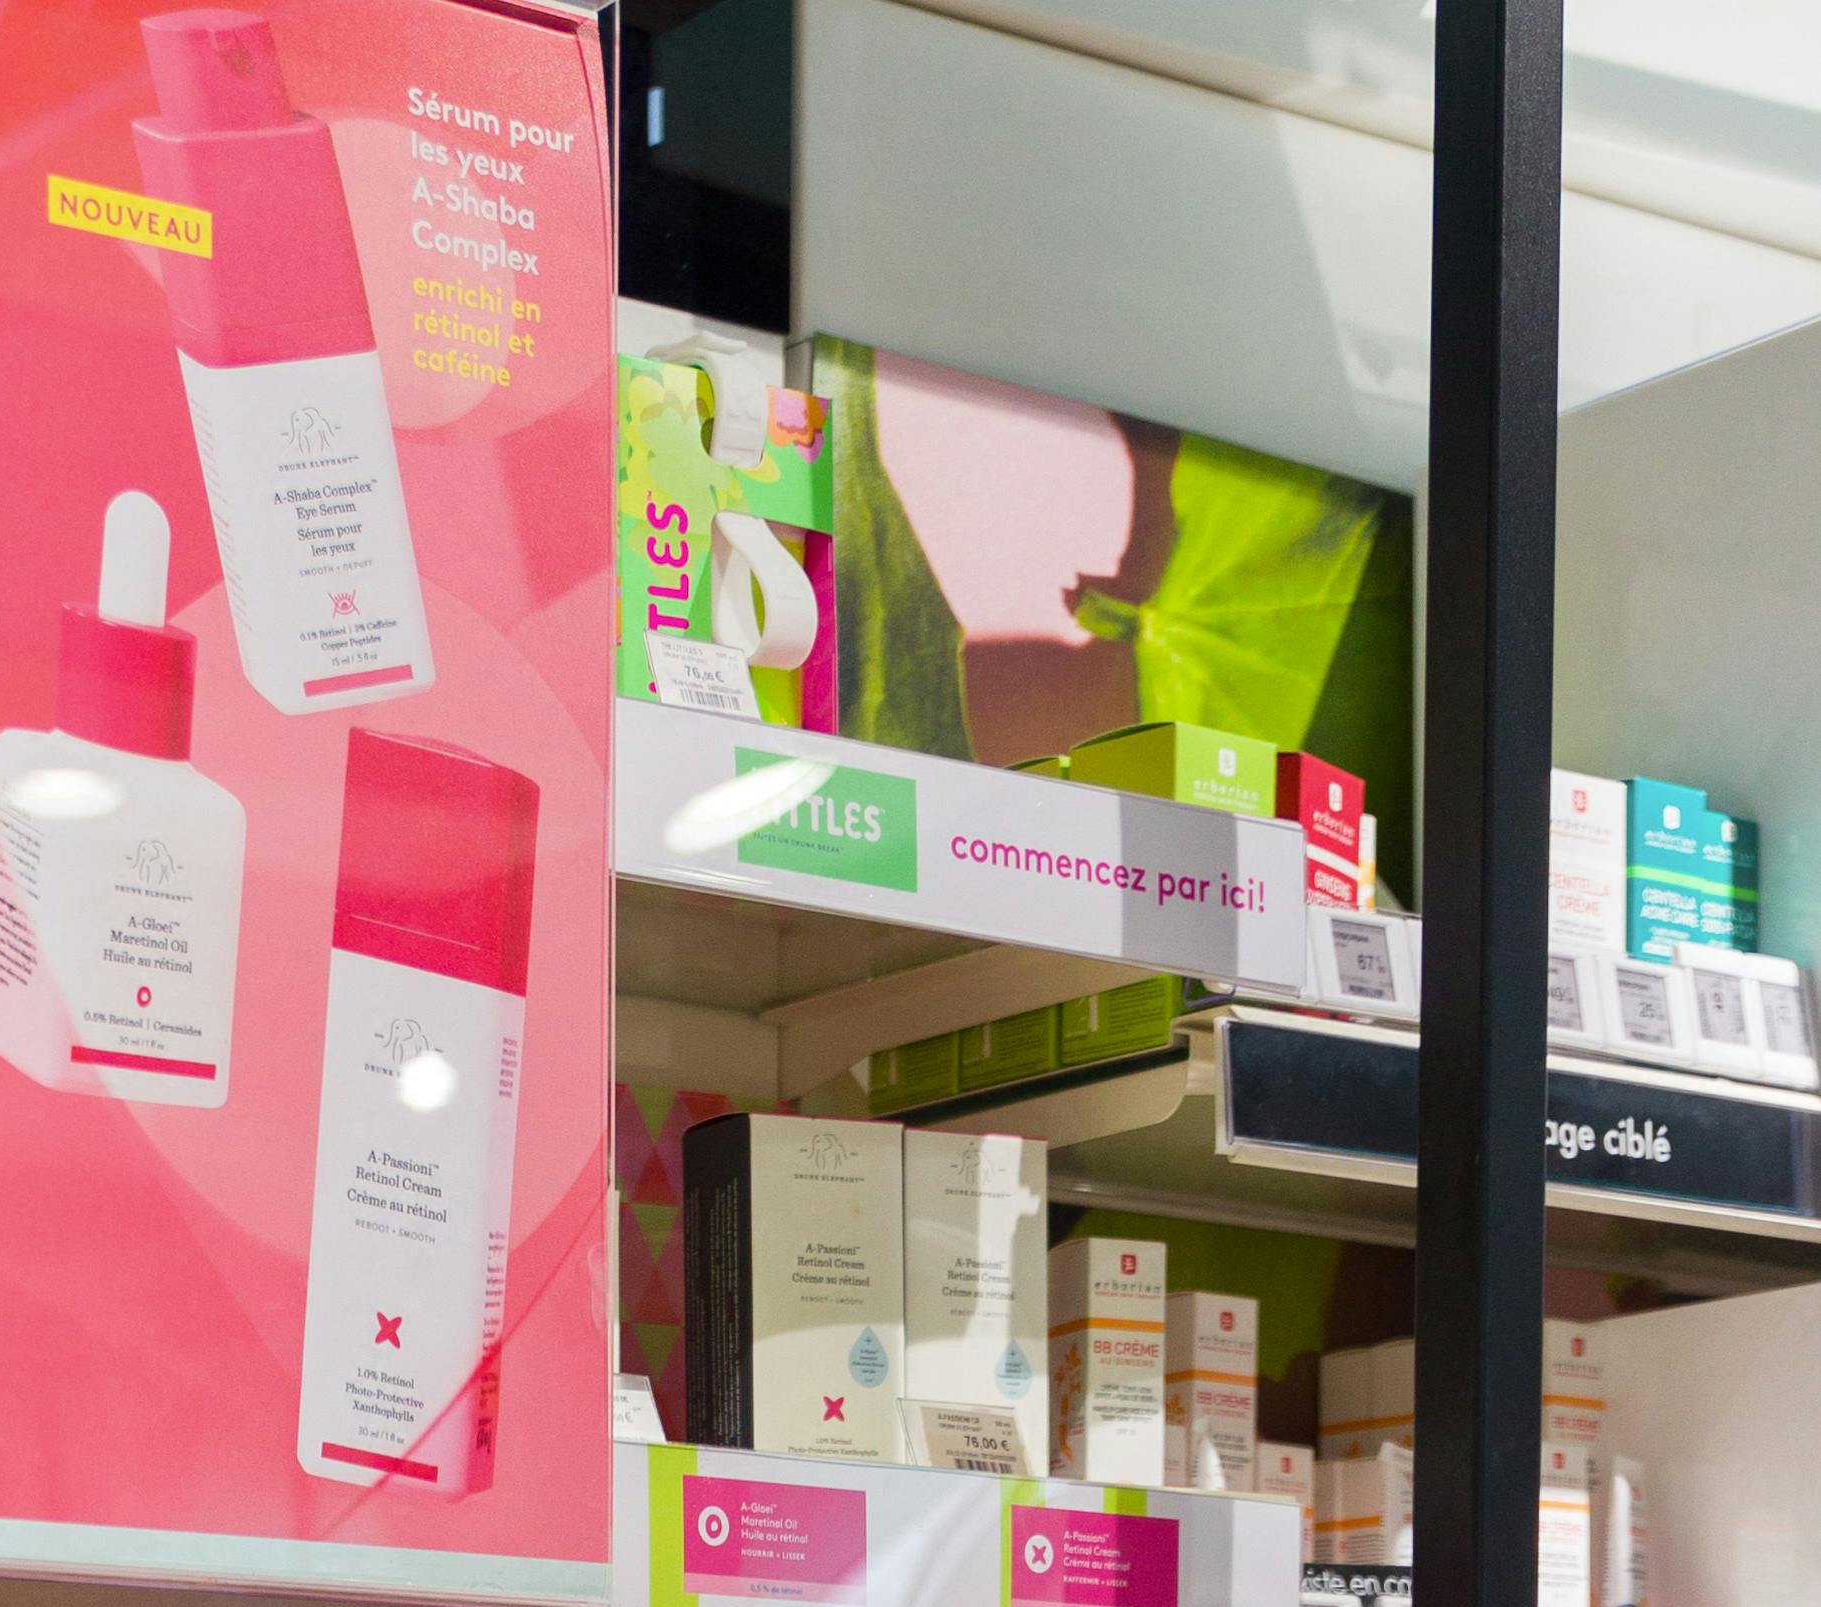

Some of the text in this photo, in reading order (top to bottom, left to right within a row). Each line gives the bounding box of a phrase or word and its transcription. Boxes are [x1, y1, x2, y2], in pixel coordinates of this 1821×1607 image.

[407, 86, 576, 155] Sérum pour
[410, 132, 526, 186] les yeux
[412, 176, 536, 232] A-Shaba
[59, 191, 204, 246] NOUVEAU
[412, 220, 540, 276] Complex
[413, 273, 542, 323] enrichi en
[413, 309, 535, 359] rétinol et
[413, 345, 512, 388] caféine
[273, 488, 322, 506] A-Shaba
[296, 502, 357, 520] Eye Serum
[298, 523, 363, 542] Sérum pour
[311, 542, 356, 557] les yeux
[646, 502, 690, 632] TLES
[951, 832, 1148, 894] commencez
[1156, 871, 1213, 906] par
[1221, 880, 1266, 914] ici!
[111, 930, 188, 953] Maretinol Oil
[103, 949, 192, 974] Huile au rétinol
[109, 1014, 202, 1036] Retinol Ceramides
[1546, 1117, 1672, 1162] age ciblé
[355, 1167, 442, 1198] Retinol Cream
[347, 1189, 447, 1223] Crème au rétinol
[355, 1219, 436, 1245] REBOOT SMOOTH
[797, 1256, 864, 1270] Retinol Cream
[792, 1272, 870, 1287] Crème au rétinol
[1093, 1339, 1160, 1358] BB CRÈME
[380, 1372, 415, 1389] Retinol
[353, 1400, 415, 1423] Xanthophylls
[741, 1515, 798, 1530] Maretinol Oil
[741, 1529, 808, 1545] Huile au rétinol
